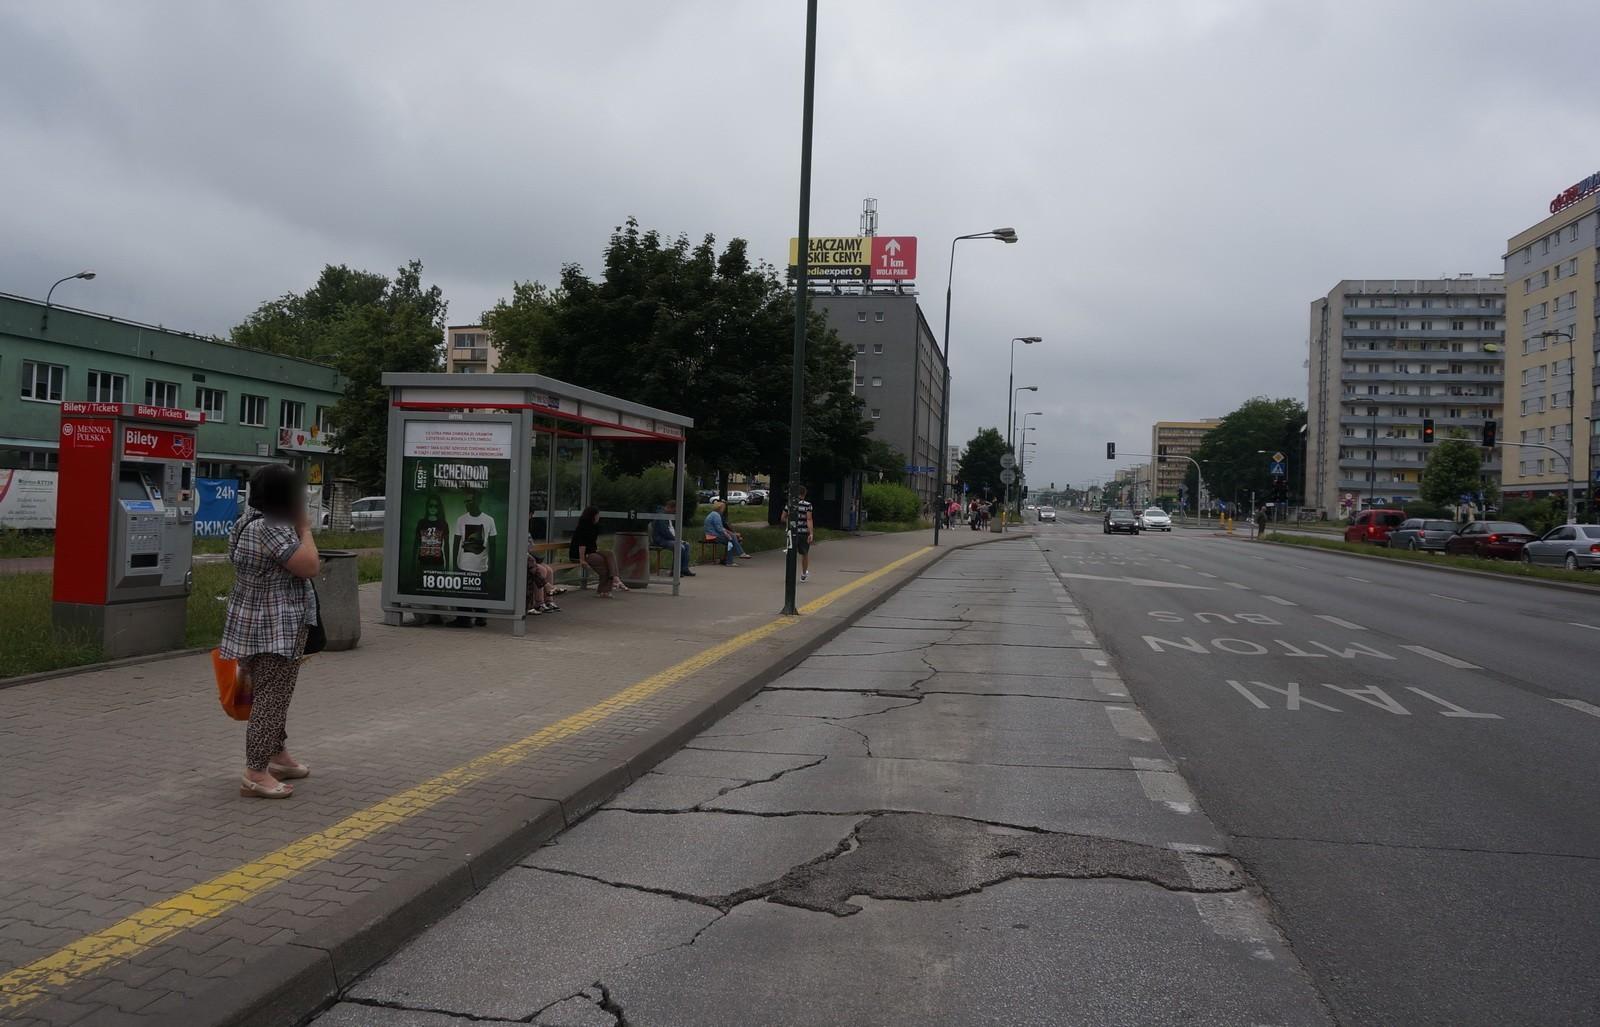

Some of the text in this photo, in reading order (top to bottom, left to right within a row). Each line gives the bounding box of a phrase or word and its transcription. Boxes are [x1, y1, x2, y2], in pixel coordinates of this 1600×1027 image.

[807, 252, 862, 263] SKIE CENY!
[881, 254, 904, 267] 1 km
[807, 267, 853, 277] diaexpert
[63, 403, 87, 414] Bilety
[92, 404, 119, 413] Tickets
[138, 406, 157, 417] Bilety
[162, 408, 183, 419] Tickets
[76, 424, 111, 434] MENNICA
[76, 433, 105, 442] POLSKA
[126, 430, 158, 448] Bilety
[433, 463, 489, 480] LECHENDOM
[215, 486, 235, 499] 24h
[195, 521, 235, 536] RKING
[423, 575, 481, 590] 18 000 EKO
[1147, 610, 1284, 626] BUS
[1140, 634, 1398, 661] MTON
[1224, 679, 1505, 720] TAXI
